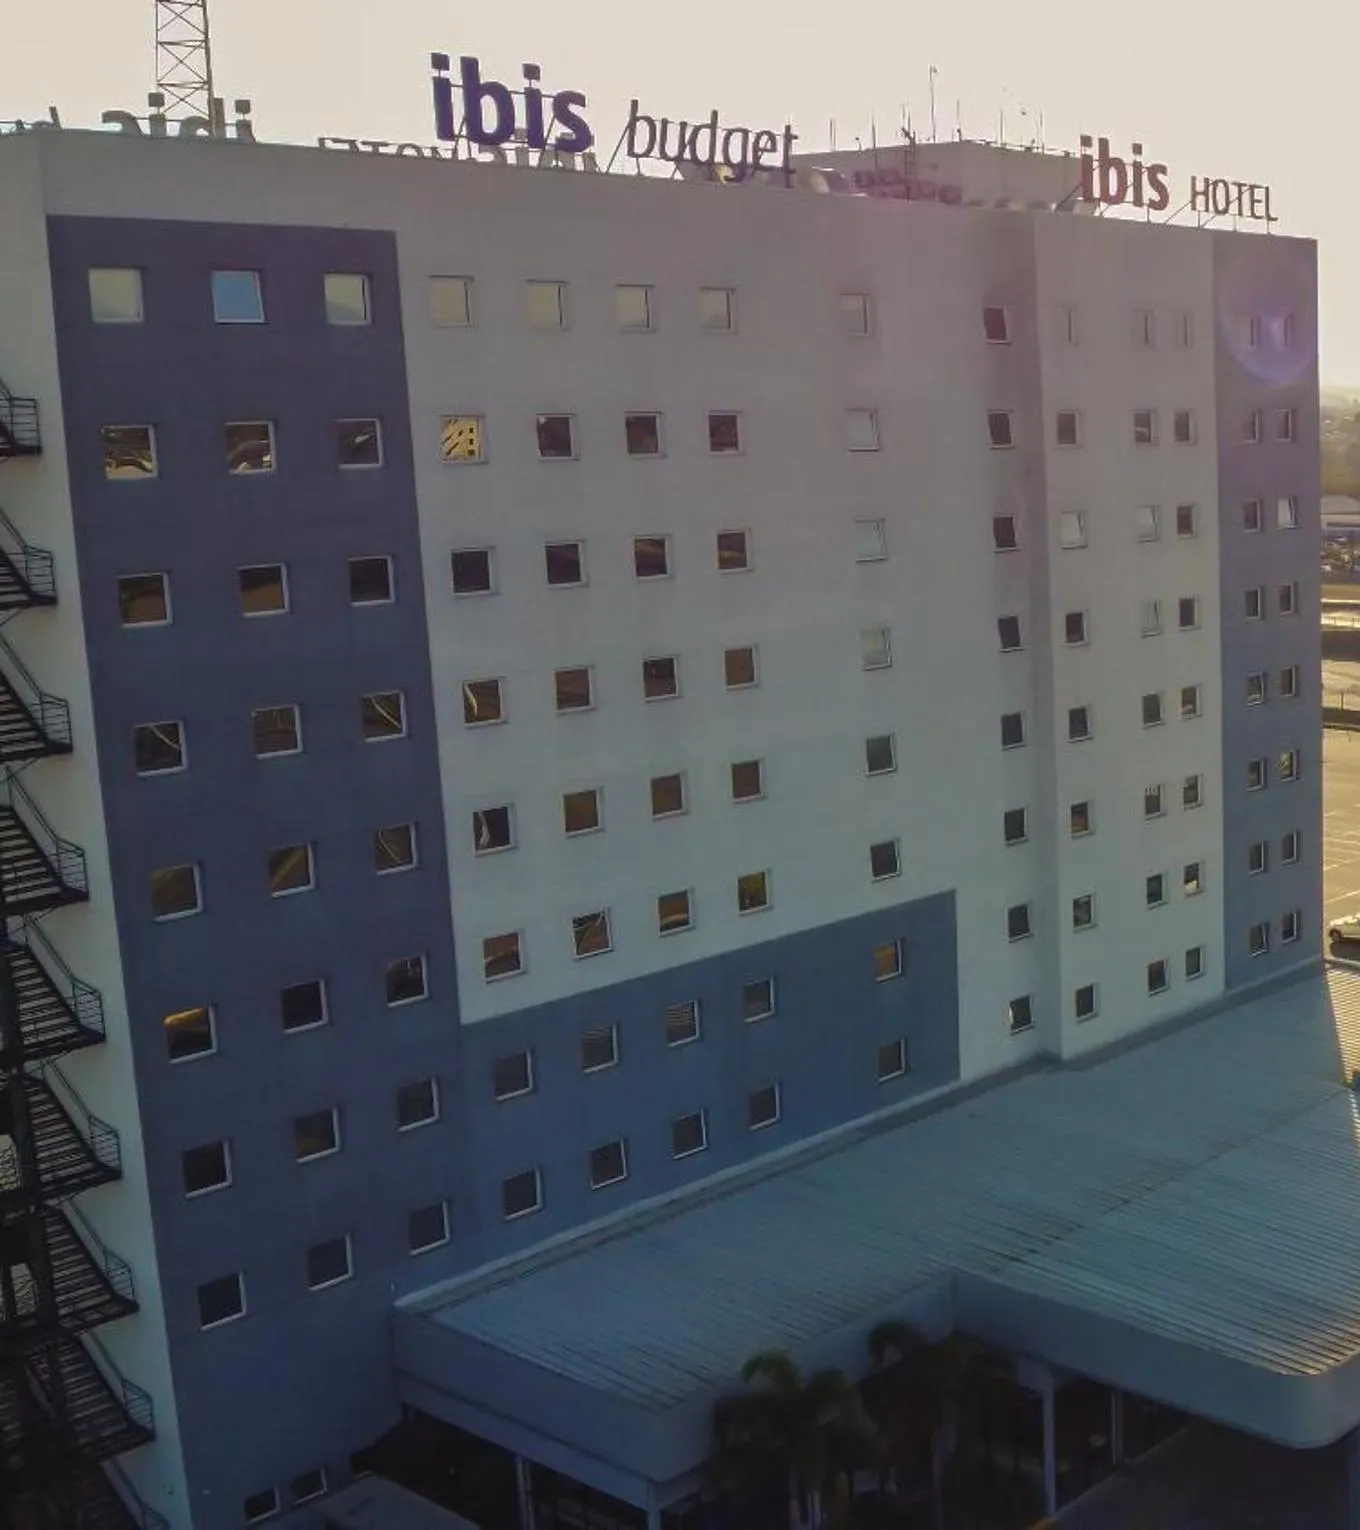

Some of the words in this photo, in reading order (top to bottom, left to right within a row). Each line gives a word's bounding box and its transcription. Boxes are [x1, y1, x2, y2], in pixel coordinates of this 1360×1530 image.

[431, 52, 593, 152] ibis
[628, 99, 799, 183] budget
[1080, 135, 1169, 211] ibis
[1191, 176, 1278, 222] HOTEL
